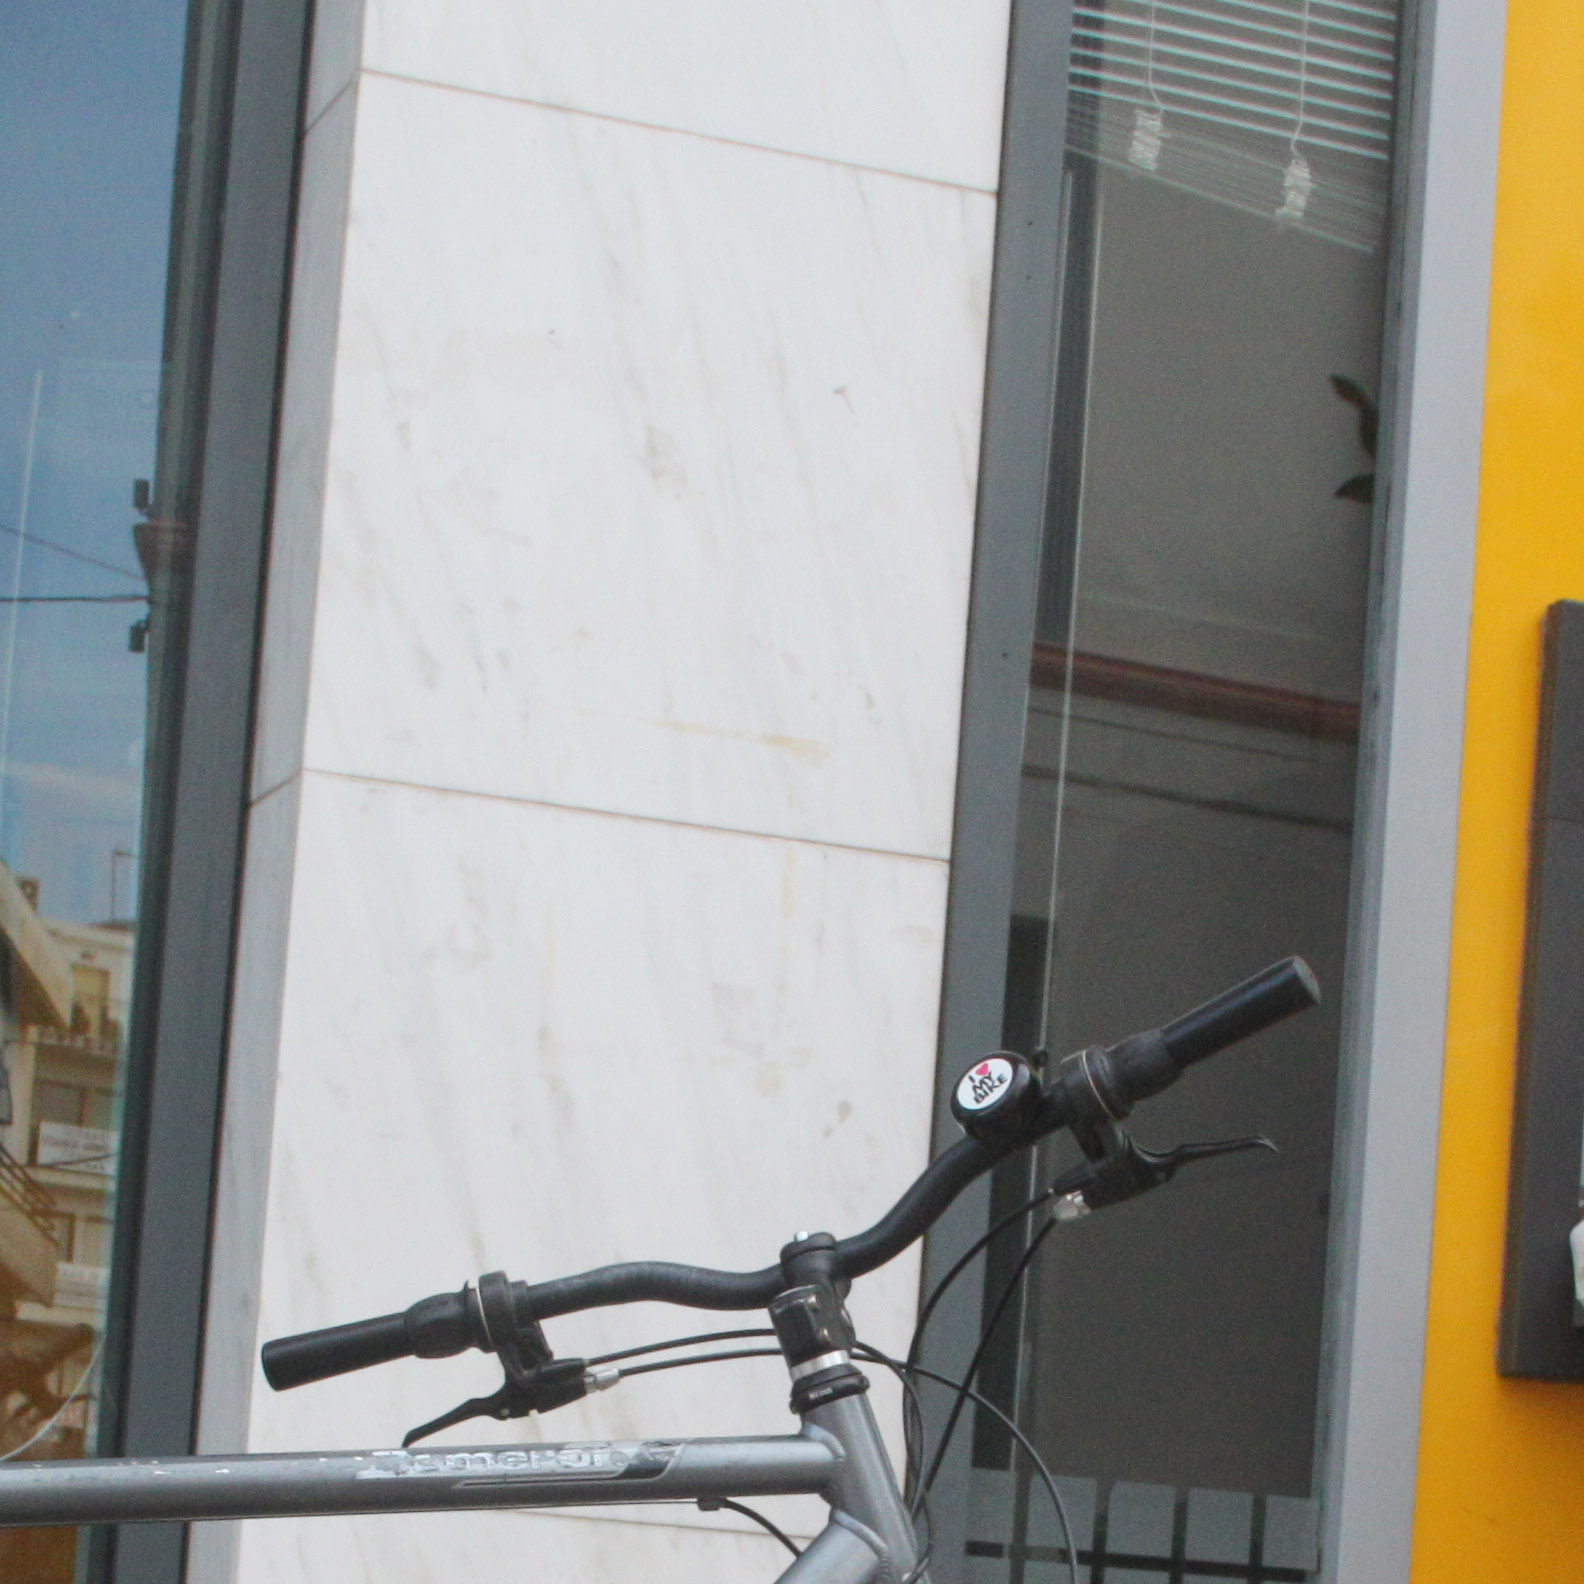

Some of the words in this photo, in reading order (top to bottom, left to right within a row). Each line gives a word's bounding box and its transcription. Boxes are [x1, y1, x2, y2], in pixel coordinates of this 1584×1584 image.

[968, 1074, 976, 1084] I
[972, 1070, 995, 1095] MY
[973, 1073, 1008, 1105] BIKE
